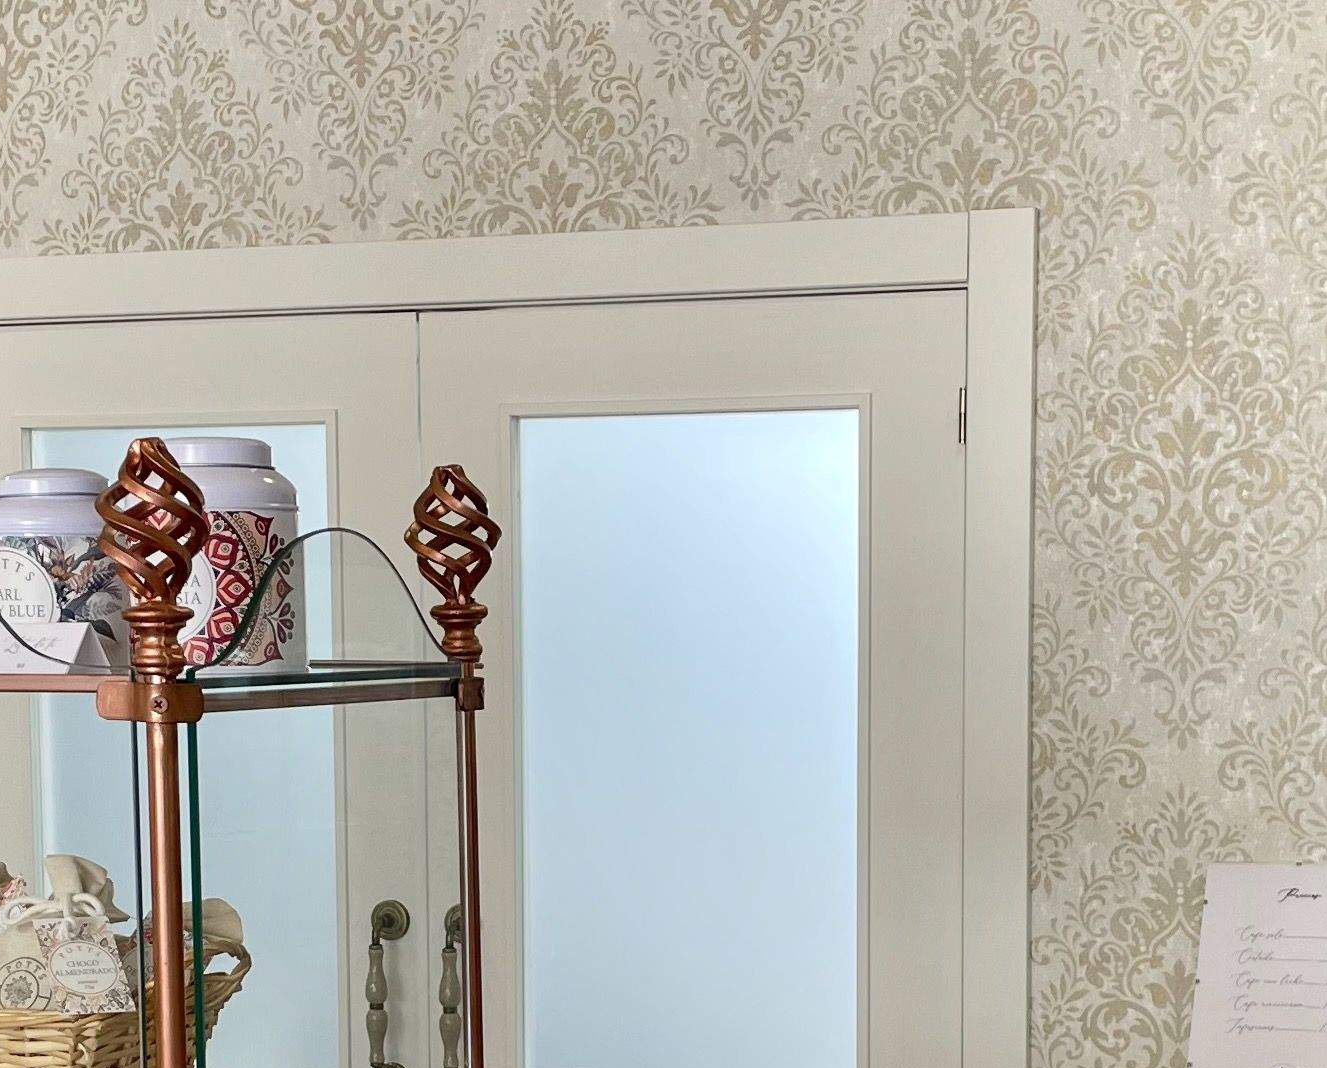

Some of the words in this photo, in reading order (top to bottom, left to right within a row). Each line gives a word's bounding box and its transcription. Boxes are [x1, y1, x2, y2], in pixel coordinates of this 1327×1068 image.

[8, 604, 47, 618] BLUE
[6, 960, 47, 980] POTTS
[66, 960, 100, 968] CHOCO
